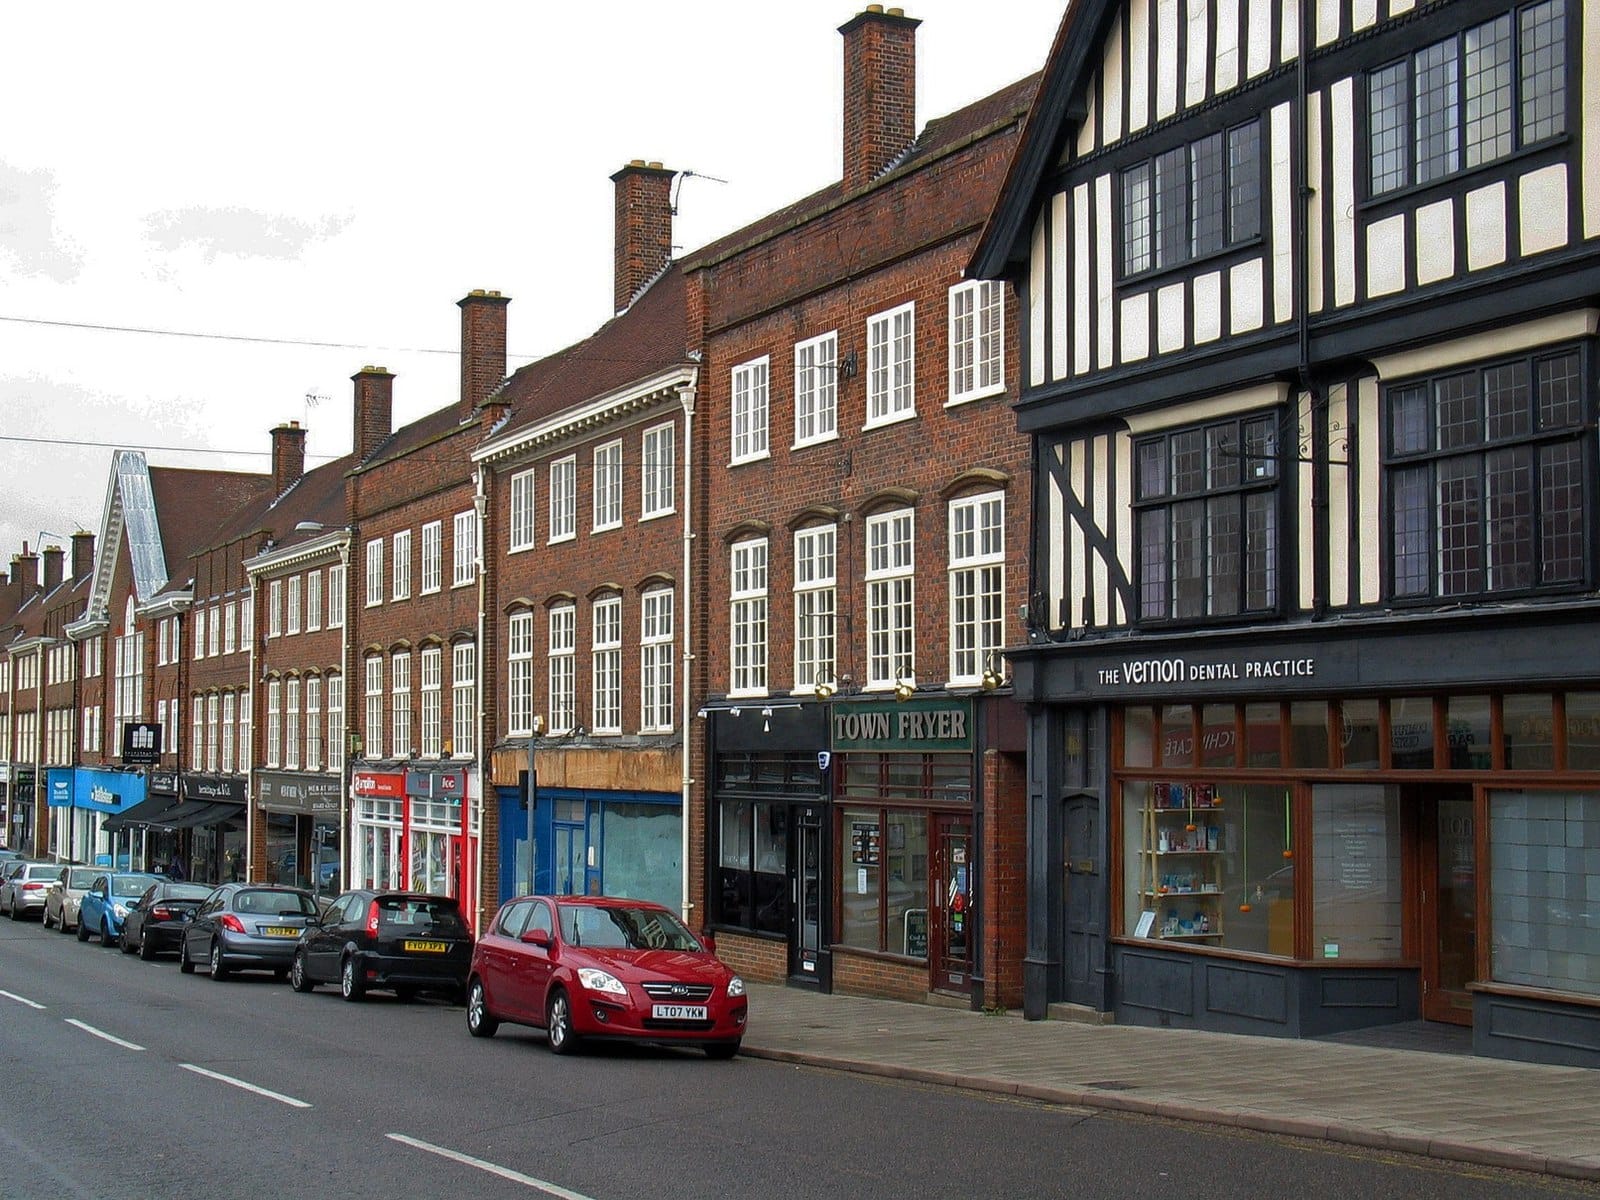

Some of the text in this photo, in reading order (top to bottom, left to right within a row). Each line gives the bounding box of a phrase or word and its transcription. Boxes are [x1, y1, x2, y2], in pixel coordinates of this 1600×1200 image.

[1099, 659, 1314, 684] THE vernon DENTAL PRACTICE
[834, 710, 966, 740] TOWN FRYER
[656, 1006, 704, 1018] LT07 YKW
